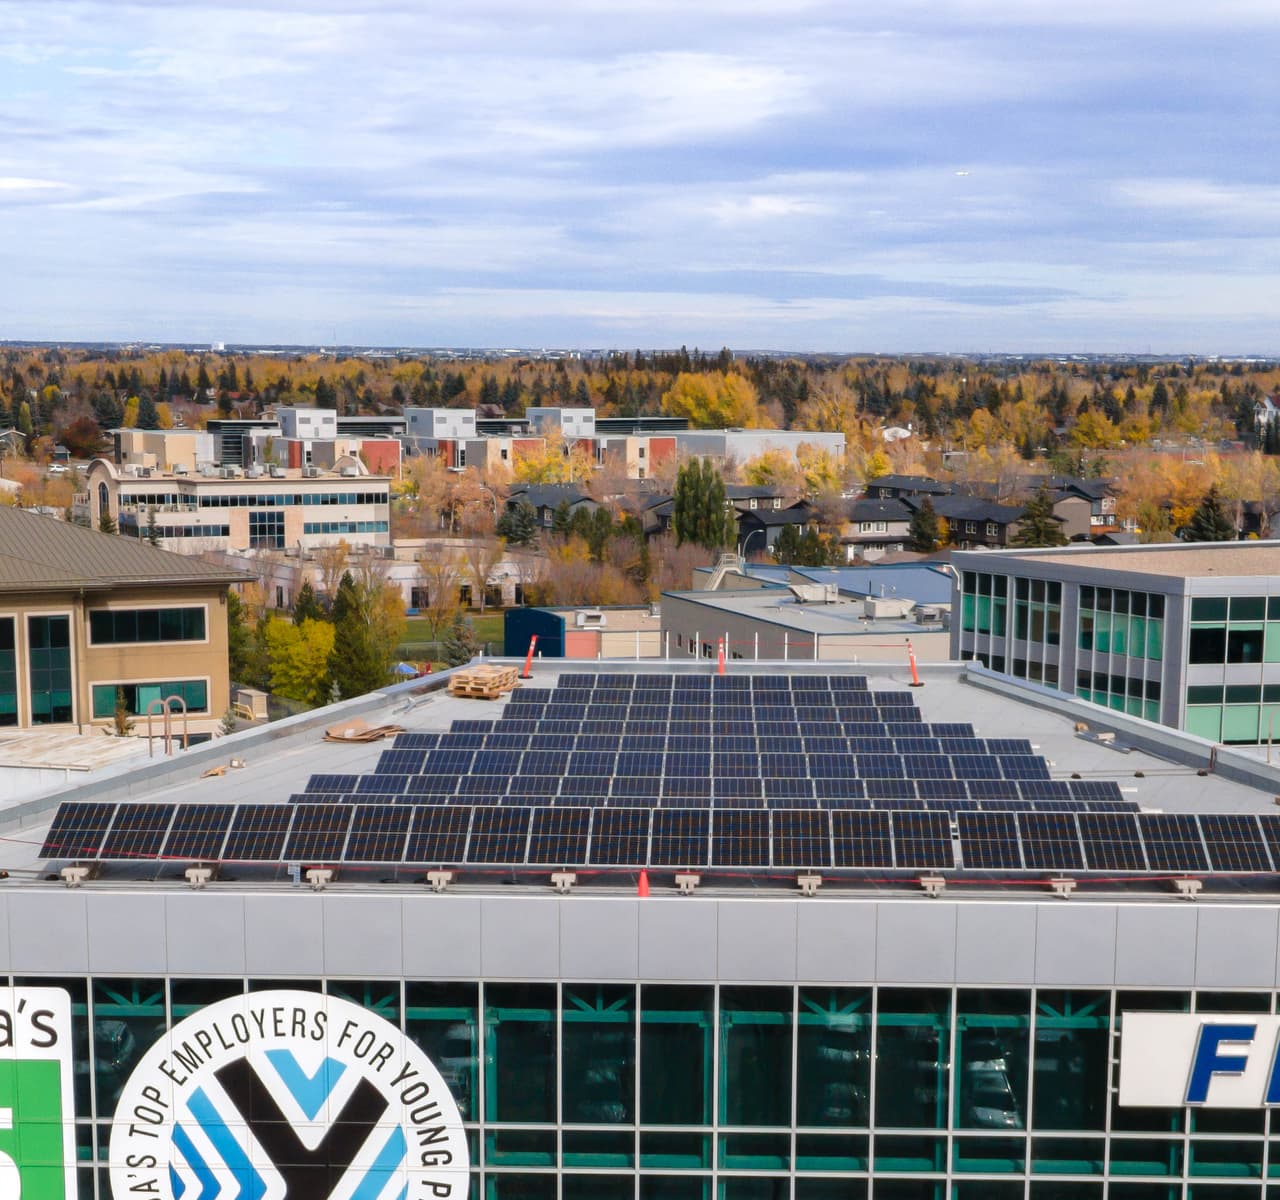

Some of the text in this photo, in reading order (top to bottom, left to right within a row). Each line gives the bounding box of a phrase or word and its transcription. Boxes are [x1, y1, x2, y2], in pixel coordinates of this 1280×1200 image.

[128, 1085, 169, 1139] TOP
[158, 1007, 328, 1087] EMPLOYERS
[337, 1020, 395, 1073] FOR
[389, 1061, 453, 1168] YOUNG
